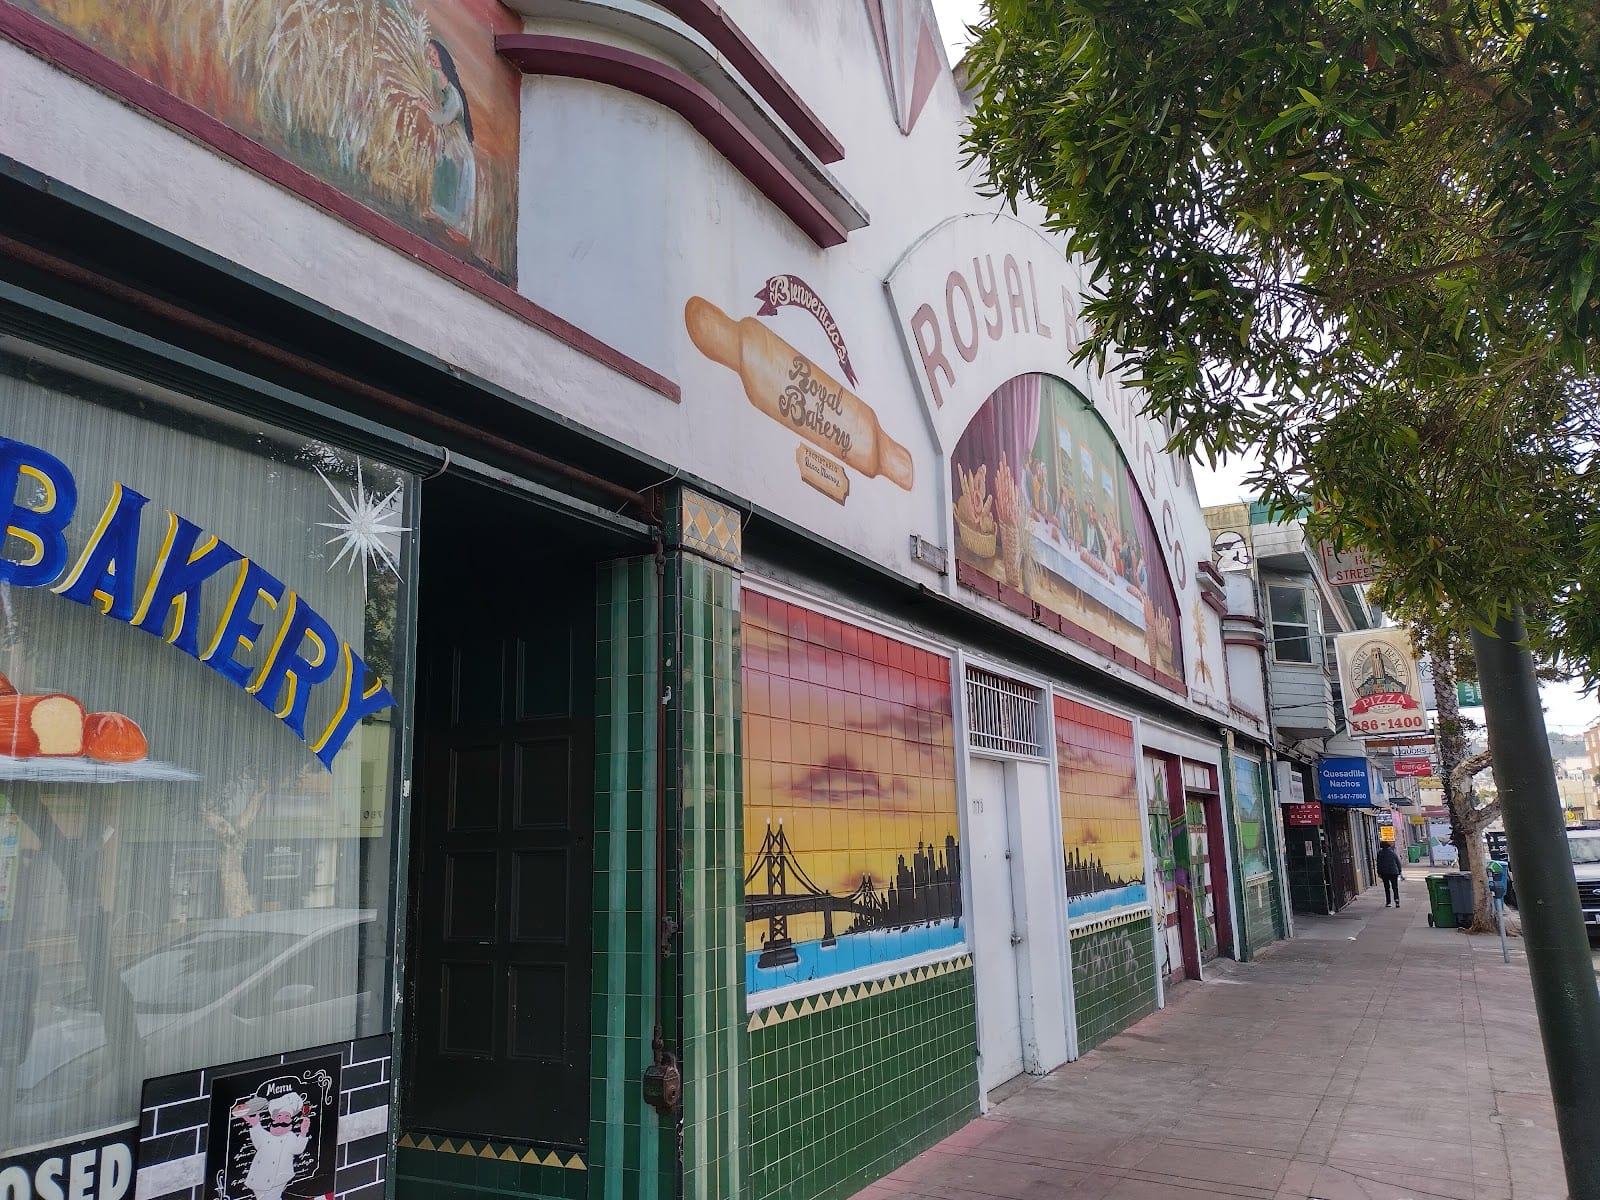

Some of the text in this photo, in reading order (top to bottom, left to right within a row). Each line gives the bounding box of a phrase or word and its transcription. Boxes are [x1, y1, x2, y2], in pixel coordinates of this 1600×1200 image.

[769, 275, 847, 364] Bienvenidos
[911, 254, 1052, 409] ROYAL
[789, 355, 843, 416] Royal
[779, 385, 852, 458] Bakery
[0, 437, 397, 774] BAKERY
[1354, 648, 1406, 681] NORTH BEACH
[1361, 694, 1407, 708] PIZZA
[1352, 716, 1422, 732] 586-1400
[1322, 769, 1366, 778] Quesadilla
[1329, 780, 1361, 788] Nachos
[266, 1083, 293, 1096] Menu
